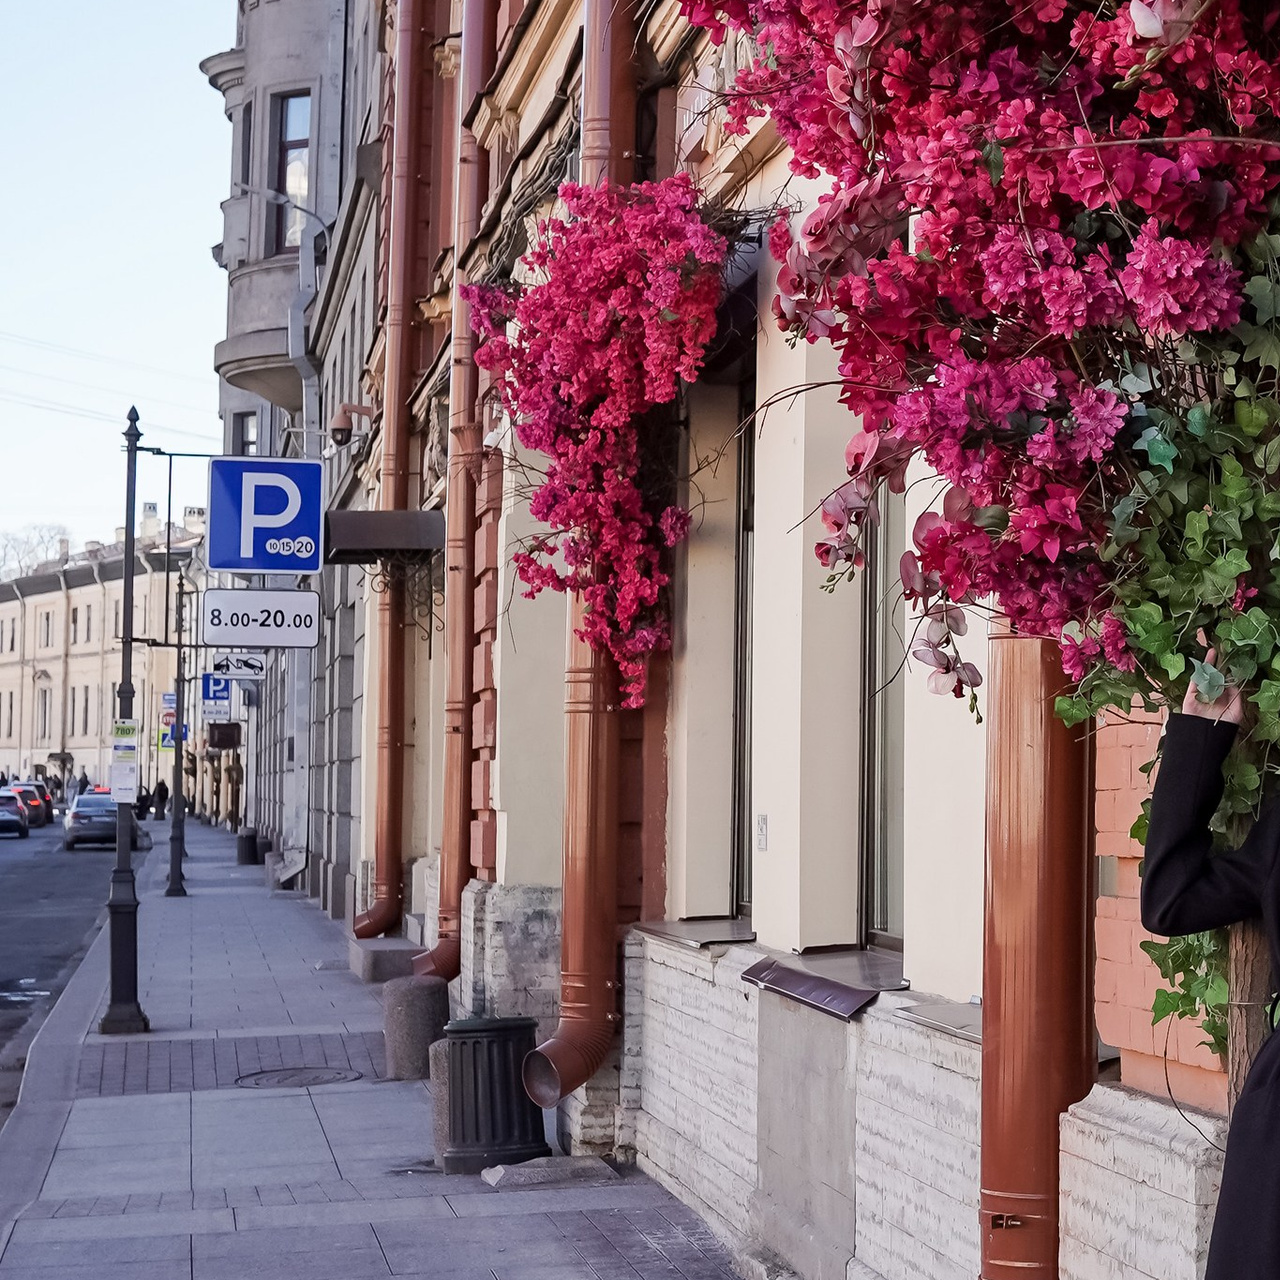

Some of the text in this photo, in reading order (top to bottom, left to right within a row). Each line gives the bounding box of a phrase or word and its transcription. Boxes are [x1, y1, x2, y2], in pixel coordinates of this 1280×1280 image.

[240, 472, 302, 558] P
[269, 541, 313, 553] 10 15 20
[210, 608, 313, 629] 8.00-20.00
[209, 676, 225, 698] P
[115, 727, 136, 736] 7807
